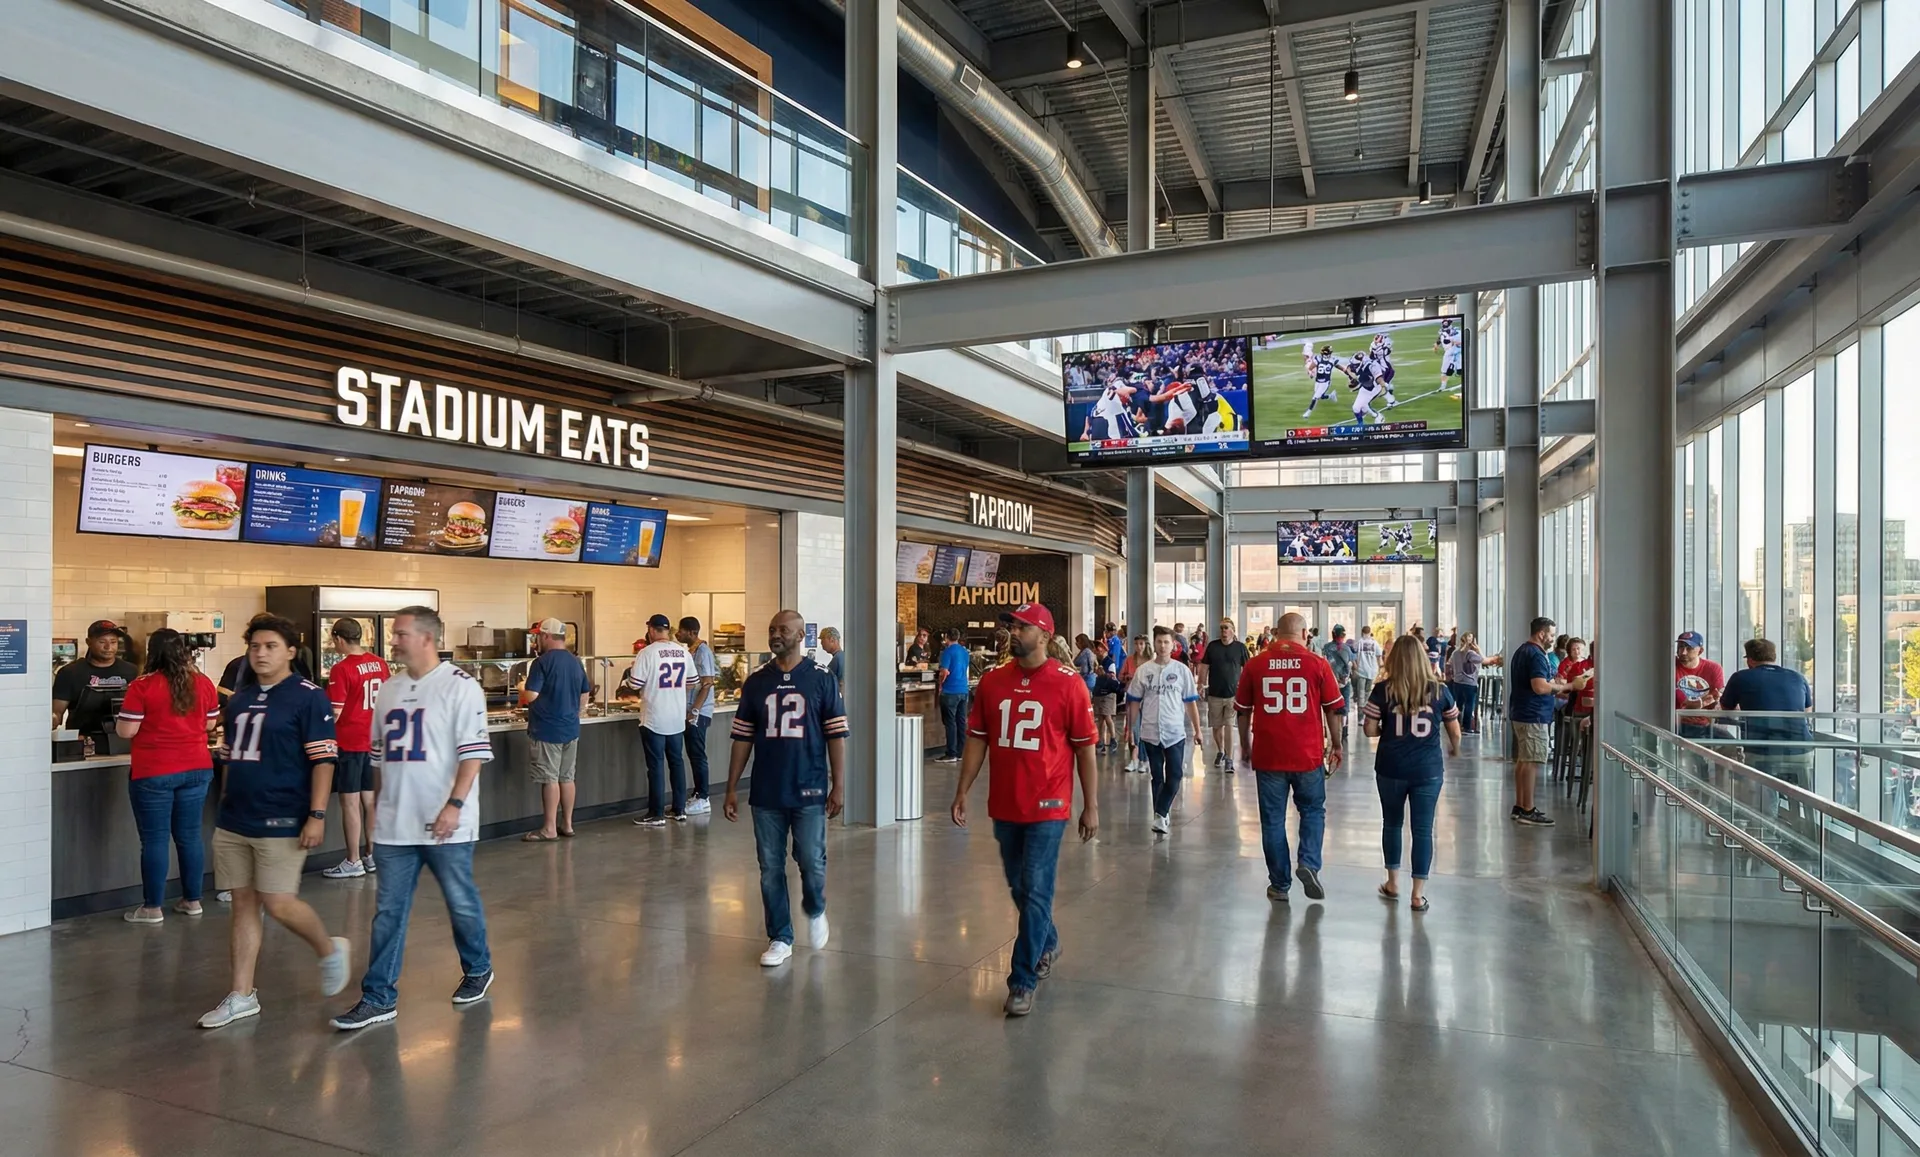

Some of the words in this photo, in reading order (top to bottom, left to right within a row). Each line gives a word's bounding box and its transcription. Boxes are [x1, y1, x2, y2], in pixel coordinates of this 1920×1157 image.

[337, 366, 545, 454] STADIUM
[561, 408, 649, 470] EATS
[93, 452, 141, 466] BURGERS
[255, 469, 287, 482] DRINKS
[970, 492, 1033, 534] TAPROOM
[950, 582, 1040, 605] TAPROOM
[659, 662, 686, 689] 27
[1262, 676, 1307, 714] 58
[384, 708, 427, 762] 21
[765, 693, 806, 738] 12
[998, 699, 1044, 751] 12
[1391, 704, 1434, 738] 16
[230, 712, 266, 761] 11
